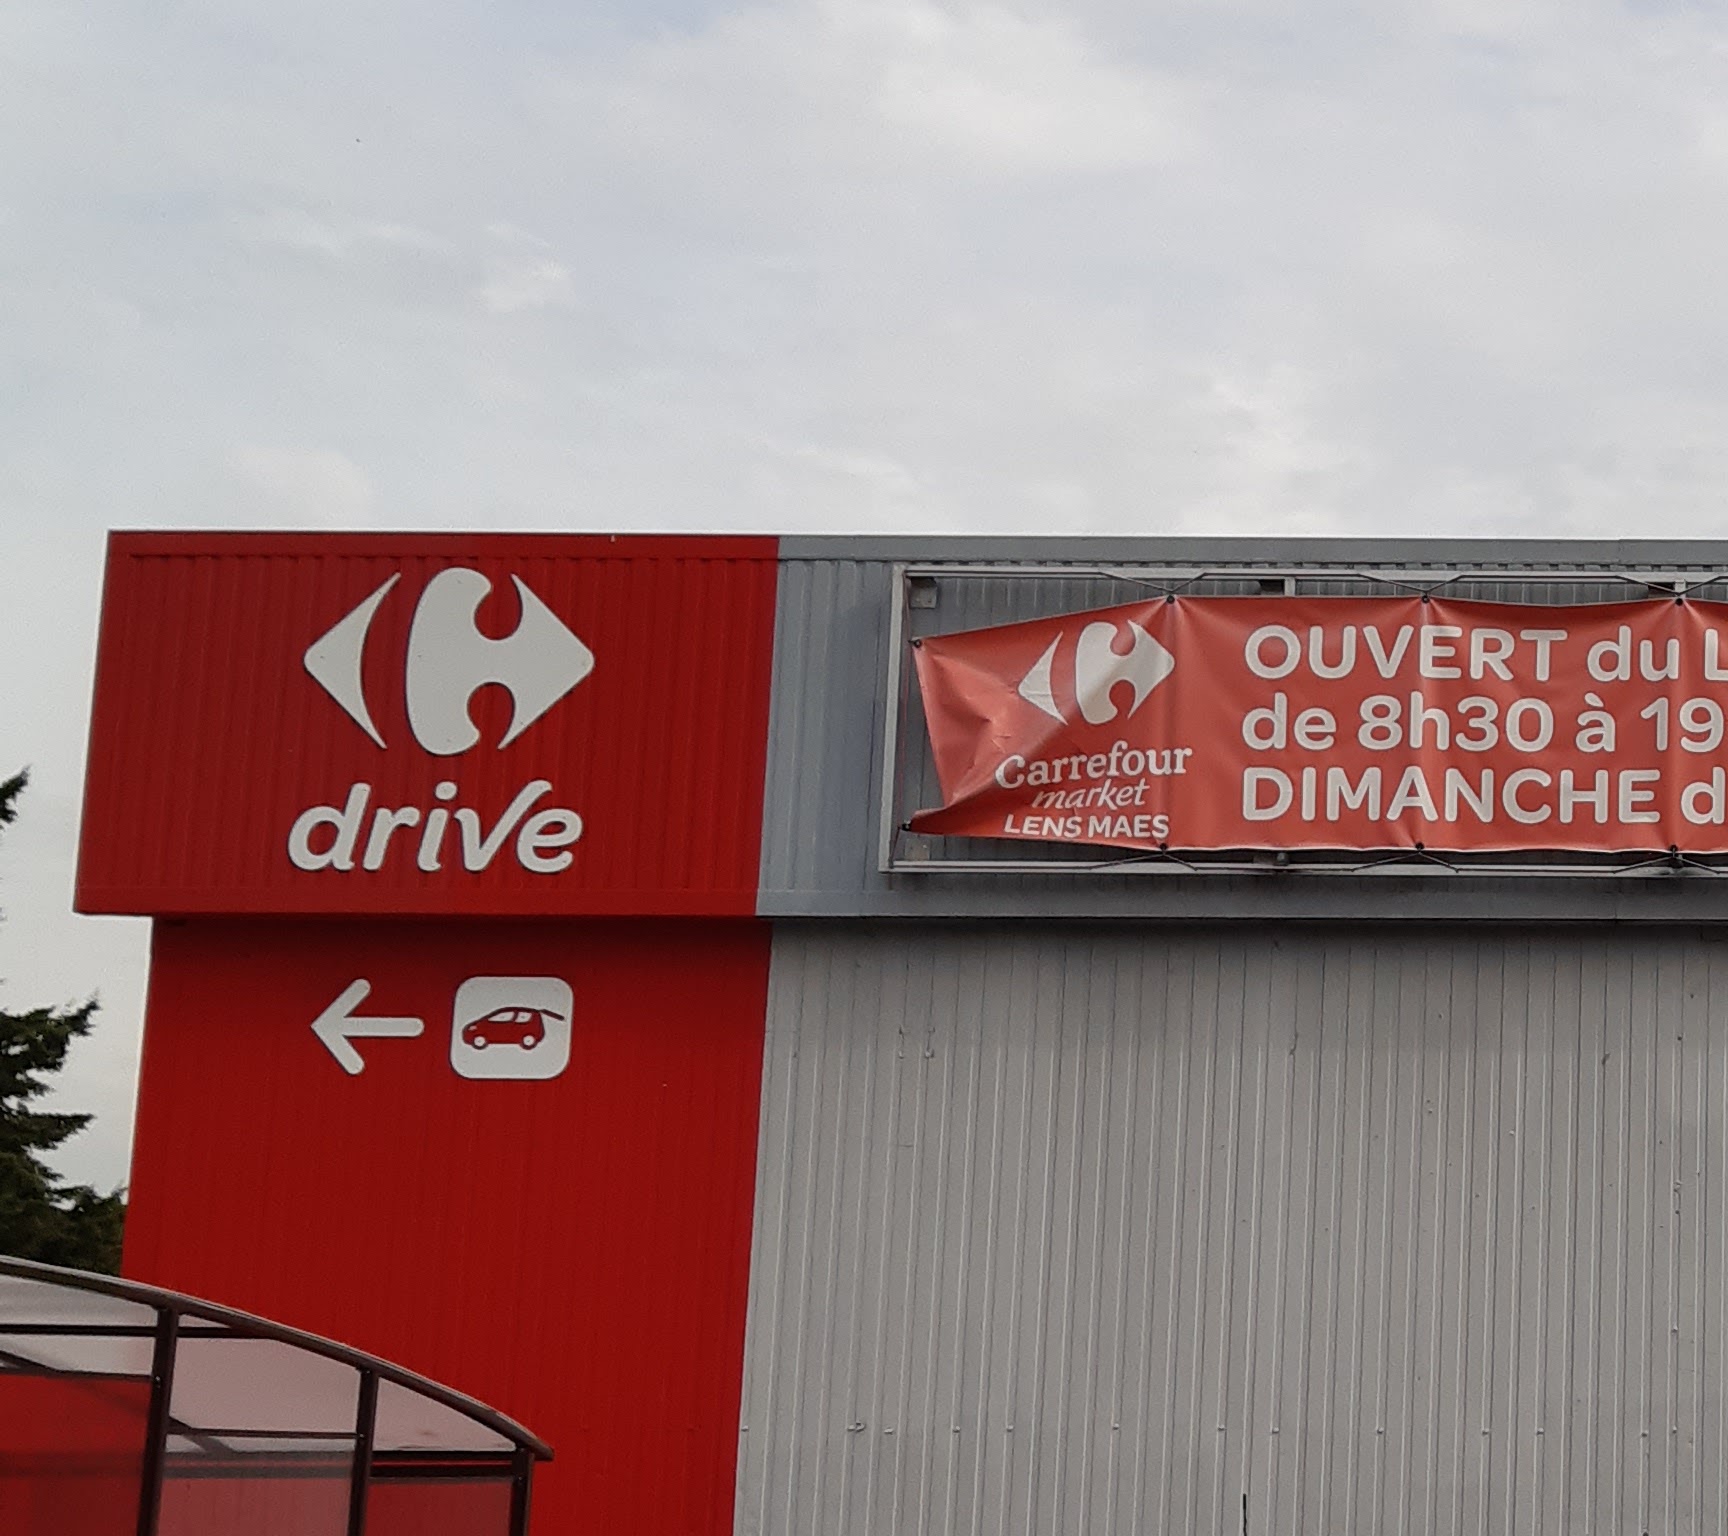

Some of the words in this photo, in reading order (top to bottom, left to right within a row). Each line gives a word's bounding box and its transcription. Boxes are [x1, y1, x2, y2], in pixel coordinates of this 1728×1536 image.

[1244, 625, 1568, 681] OUVERT
[1587, 625, 1680, 683] du
[1242, 692, 1337, 750] de
[1358, 694, 1555, 753] 8h30
[1576, 693, 1617, 753] à
[995, 740, 1193, 788] Carrefour
[1032, 778, 1150, 811] market
[1242, 767, 1661, 823] DIMANCHE
[287, 779, 583, 874] drive
[1004, 814, 1082, 838] LENS
[1088, 815, 1169, 838] MAES
